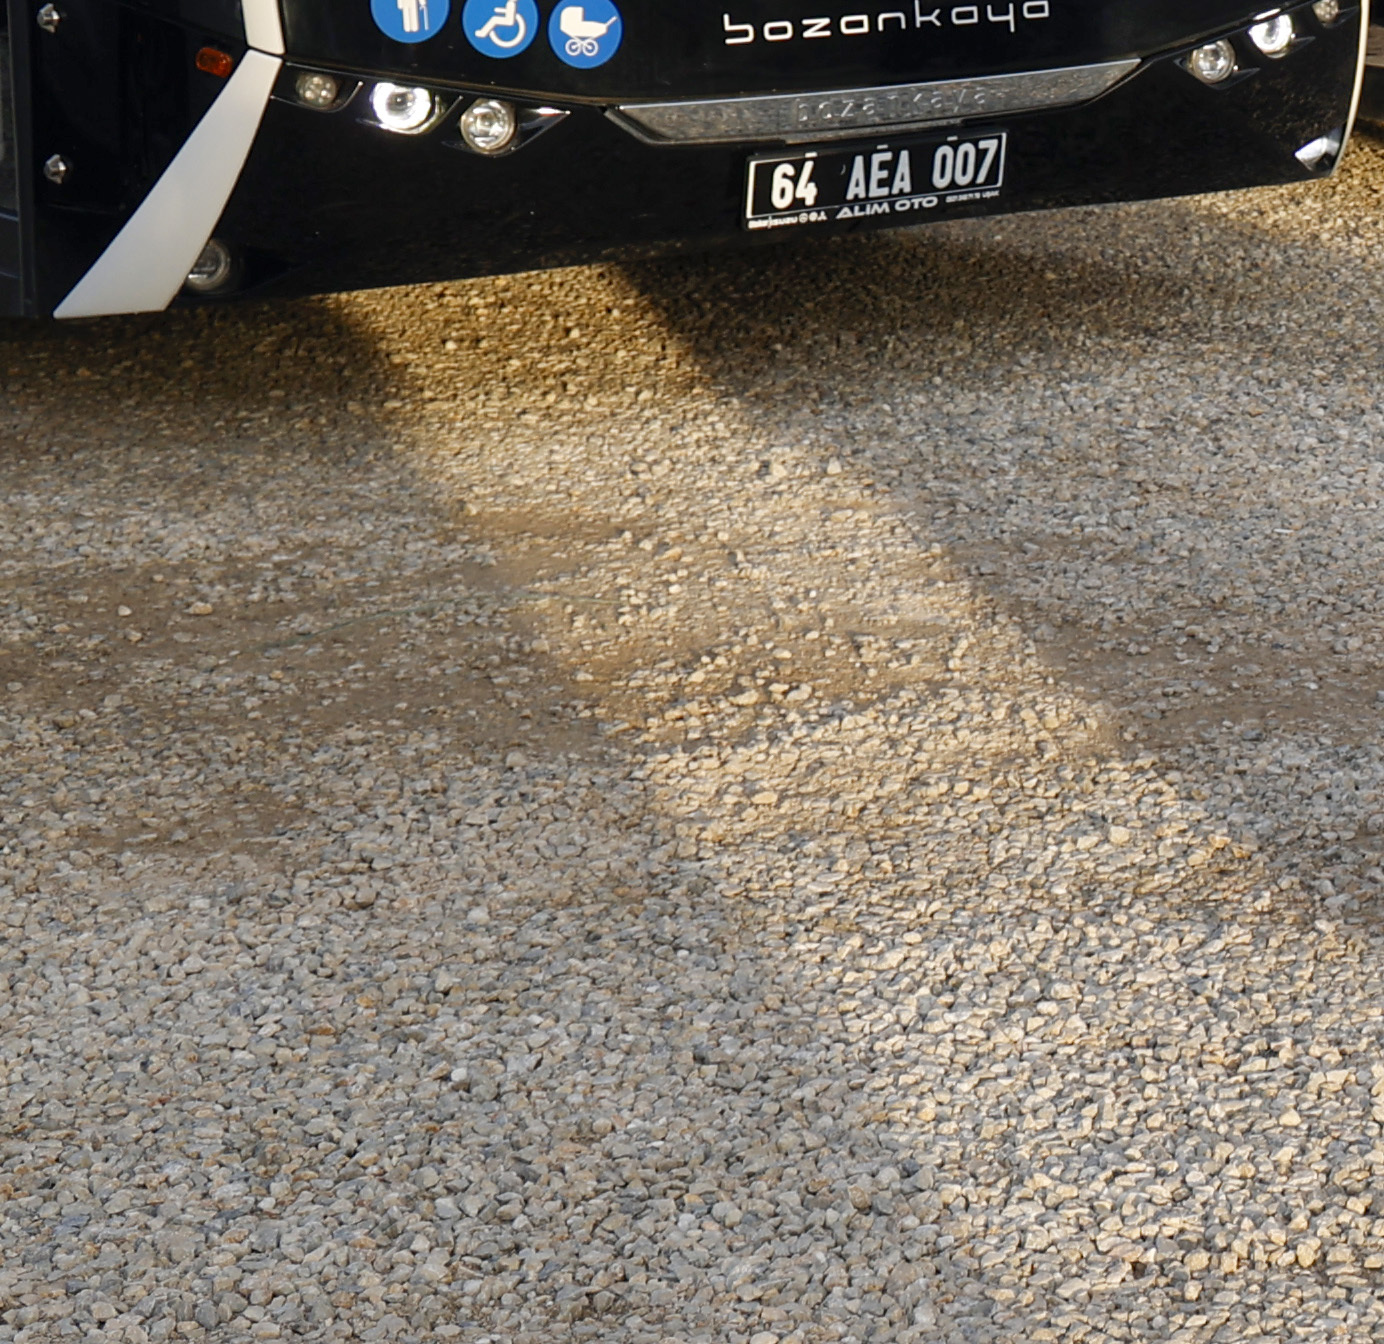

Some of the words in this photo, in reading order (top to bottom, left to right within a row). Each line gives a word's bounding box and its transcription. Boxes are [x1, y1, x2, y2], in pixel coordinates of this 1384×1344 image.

[771, 161, 818, 209] 64
[846, 150, 912, 201] AEA
[932, 138, 999, 189] 007
[895, 196, 939, 212] OTO
